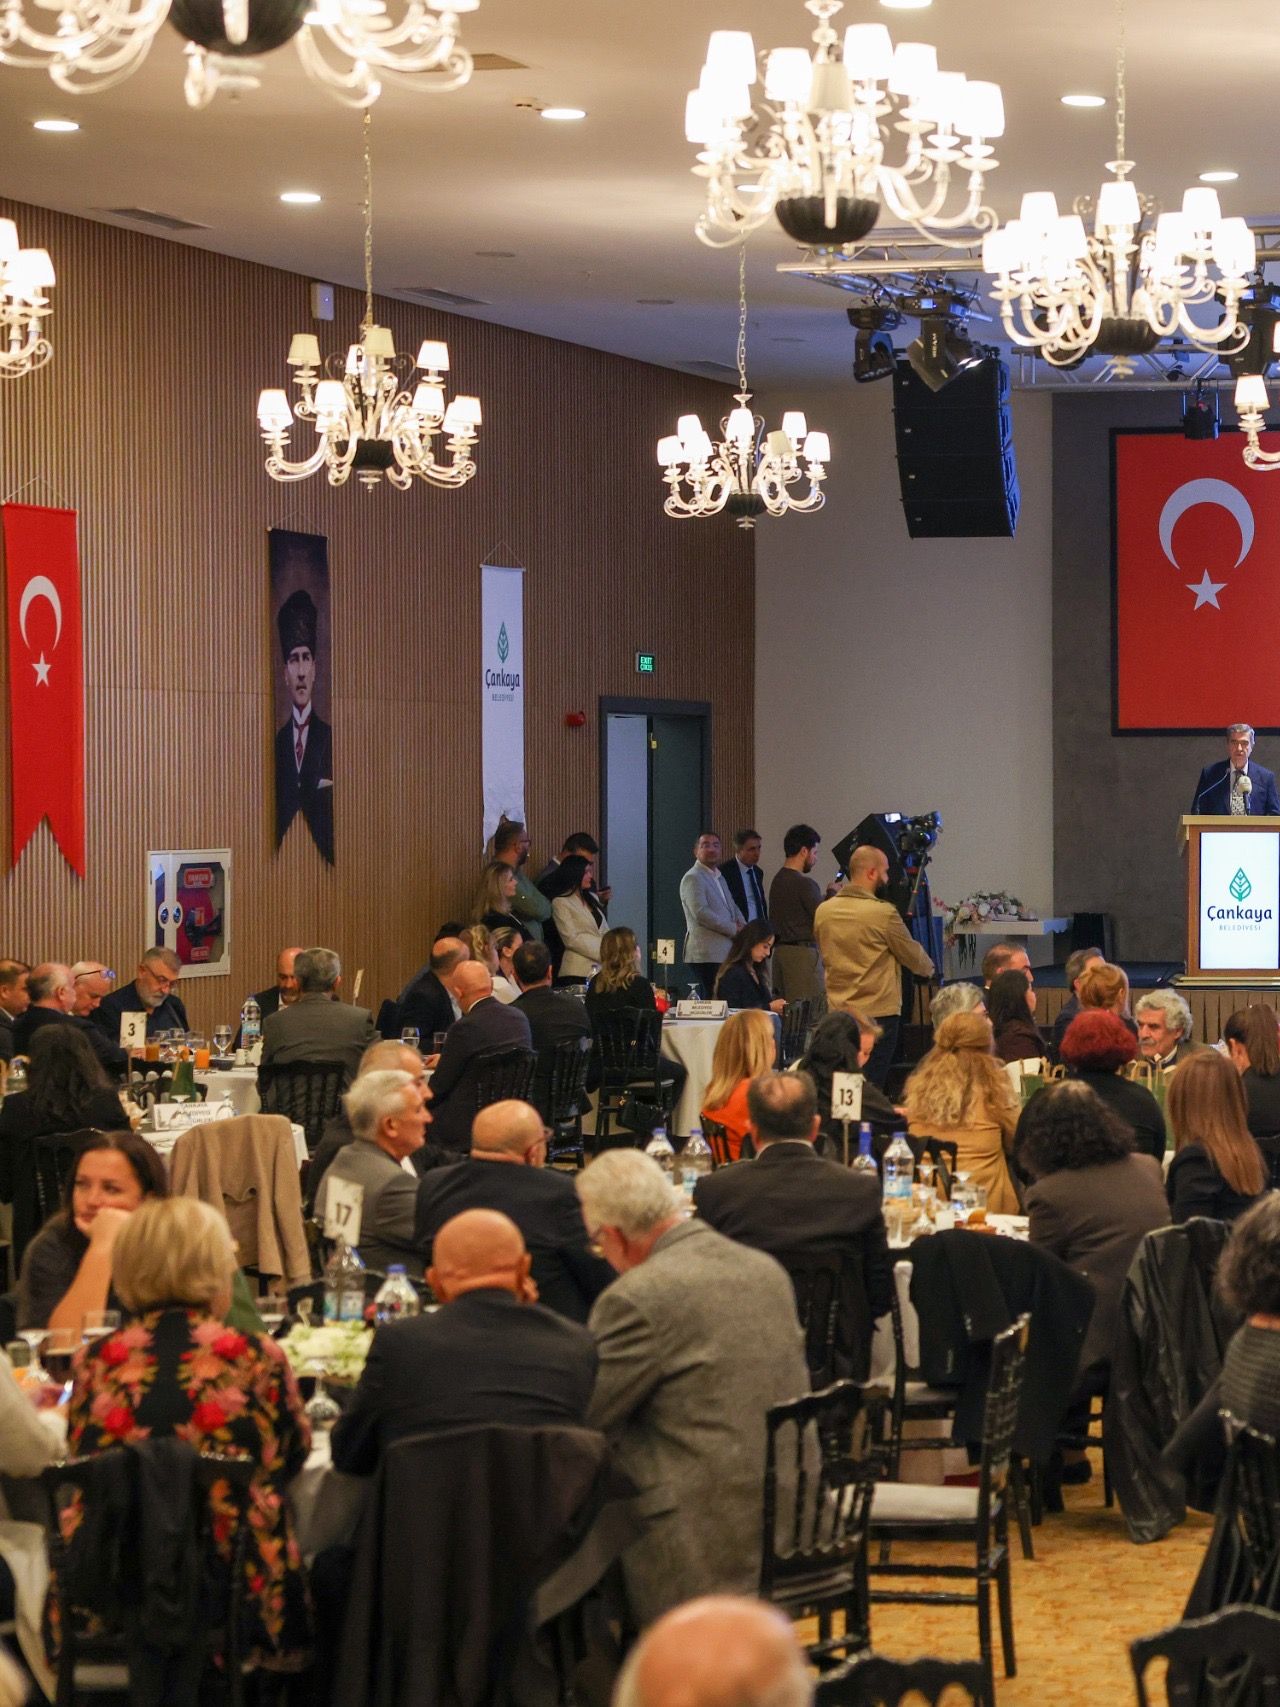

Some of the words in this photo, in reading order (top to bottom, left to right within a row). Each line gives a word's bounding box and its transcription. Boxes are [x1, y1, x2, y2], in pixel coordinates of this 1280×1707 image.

[640, 656, 653, 665] EXIT
[485, 669, 520, 691] Çankaya
[1207, 905, 1272, 922] Çankaya
[662, 946, 668, 956] 4
[127, 1023, 135, 1036] 3
[840, 1088, 853, 1106] 13
[336, 1202, 352, 1226] 17
